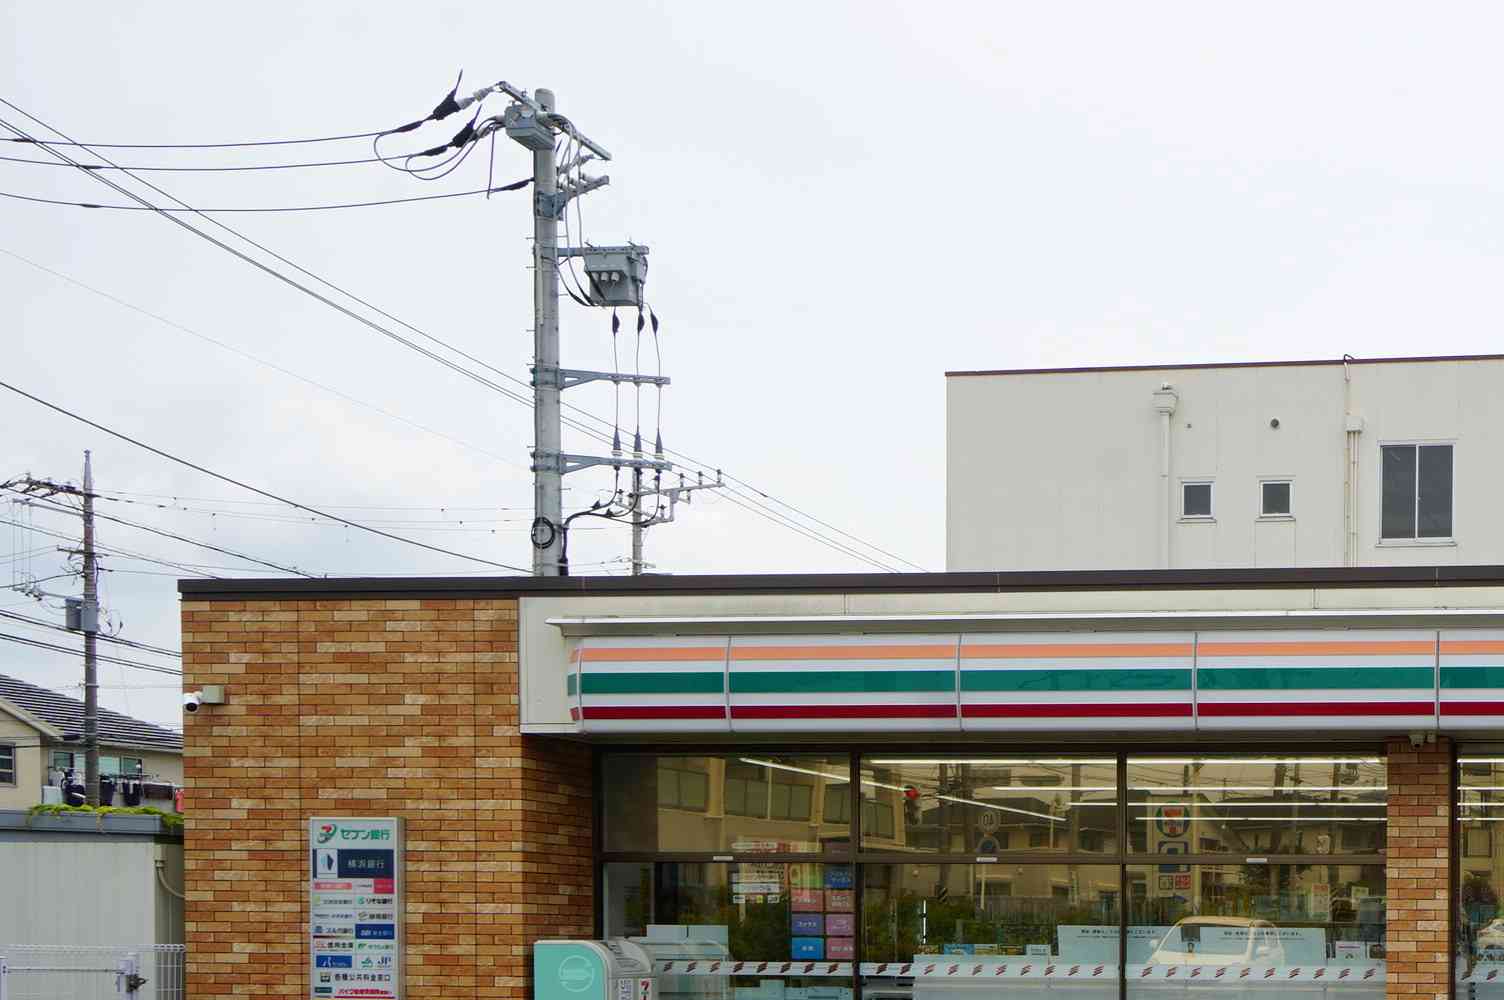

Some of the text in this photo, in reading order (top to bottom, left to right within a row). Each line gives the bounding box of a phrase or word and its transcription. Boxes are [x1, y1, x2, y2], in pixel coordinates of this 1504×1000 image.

[340, 829, 391, 840] セブン銀行
